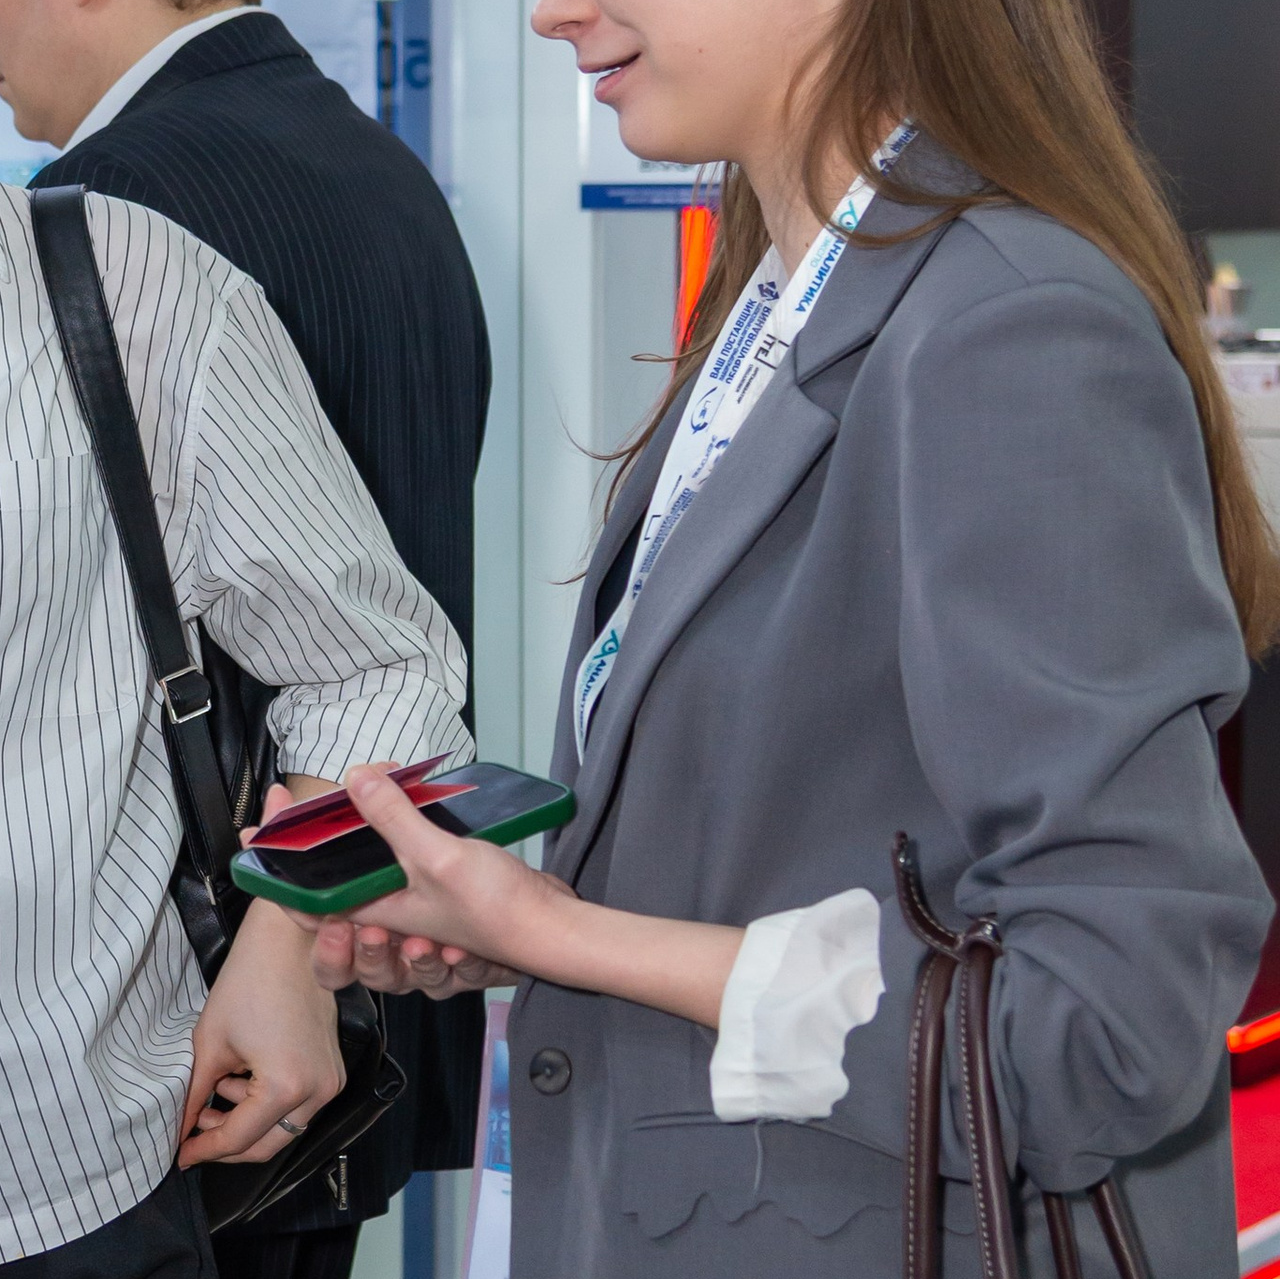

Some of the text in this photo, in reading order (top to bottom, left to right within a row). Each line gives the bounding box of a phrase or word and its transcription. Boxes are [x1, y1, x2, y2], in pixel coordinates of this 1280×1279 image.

[794, 237, 847, 314] АНАЛИТИКА
[709, 298, 757, 380] ВАШ ПОСТАВЩИК
